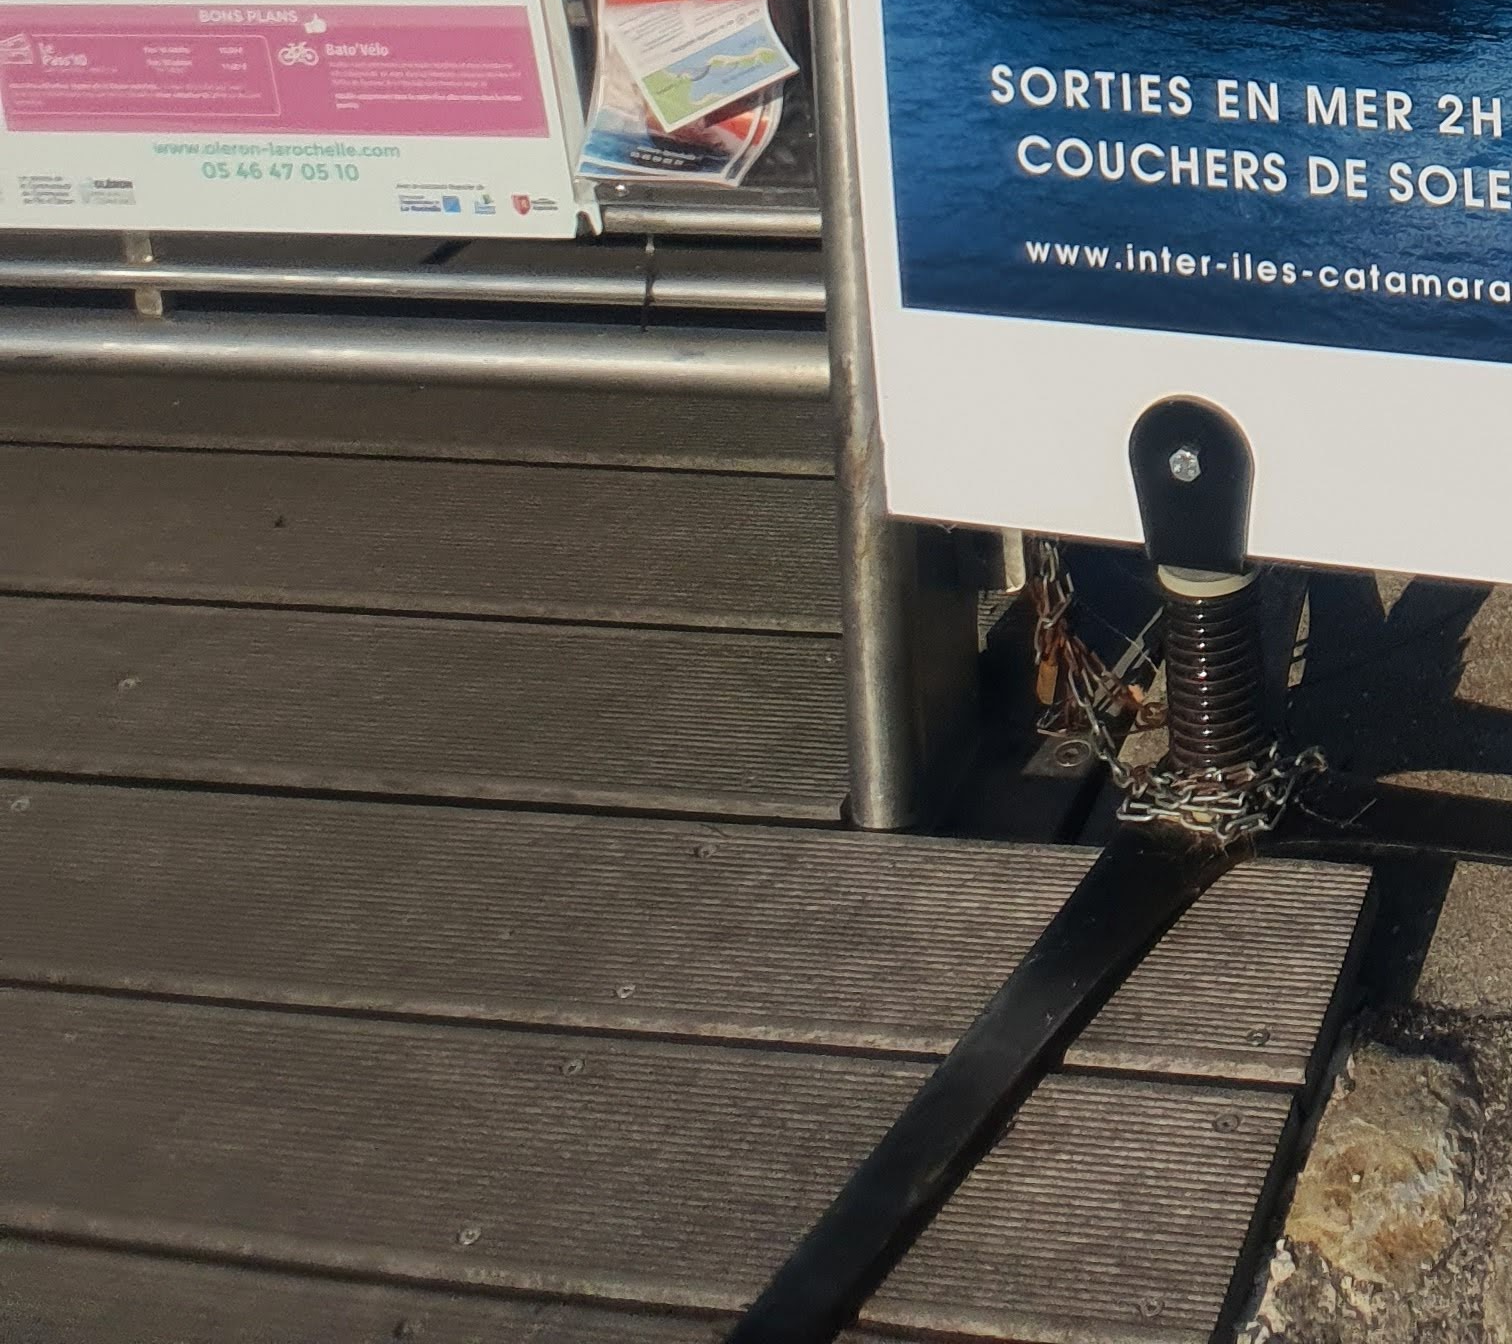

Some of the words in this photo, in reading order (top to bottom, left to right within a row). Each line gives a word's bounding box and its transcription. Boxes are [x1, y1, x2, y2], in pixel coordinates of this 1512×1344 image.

[199, 9, 243, 23] BONS
[247, 9, 298, 24] PLANS
[325, 42, 389, 57] Bato'Vélo
[989, 63, 1194, 116] SORTIES
[1217, 78, 1281, 123] EN
[1306, 84, 1414, 131] MER
[1438, 93, 1503, 137] 2H
[153, 141, 401, 159] www.oleron-larochelle.com
[202, 162, 231, 180] 05
[236, 162, 263, 180] 46
[269, 162, 294, 180] 47
[301, 162, 329, 182] 05
[335, 163, 360, 182] 10
[1016, 134, 1288, 194] COUCHERS
[1308, 155, 1369, 199] DE
